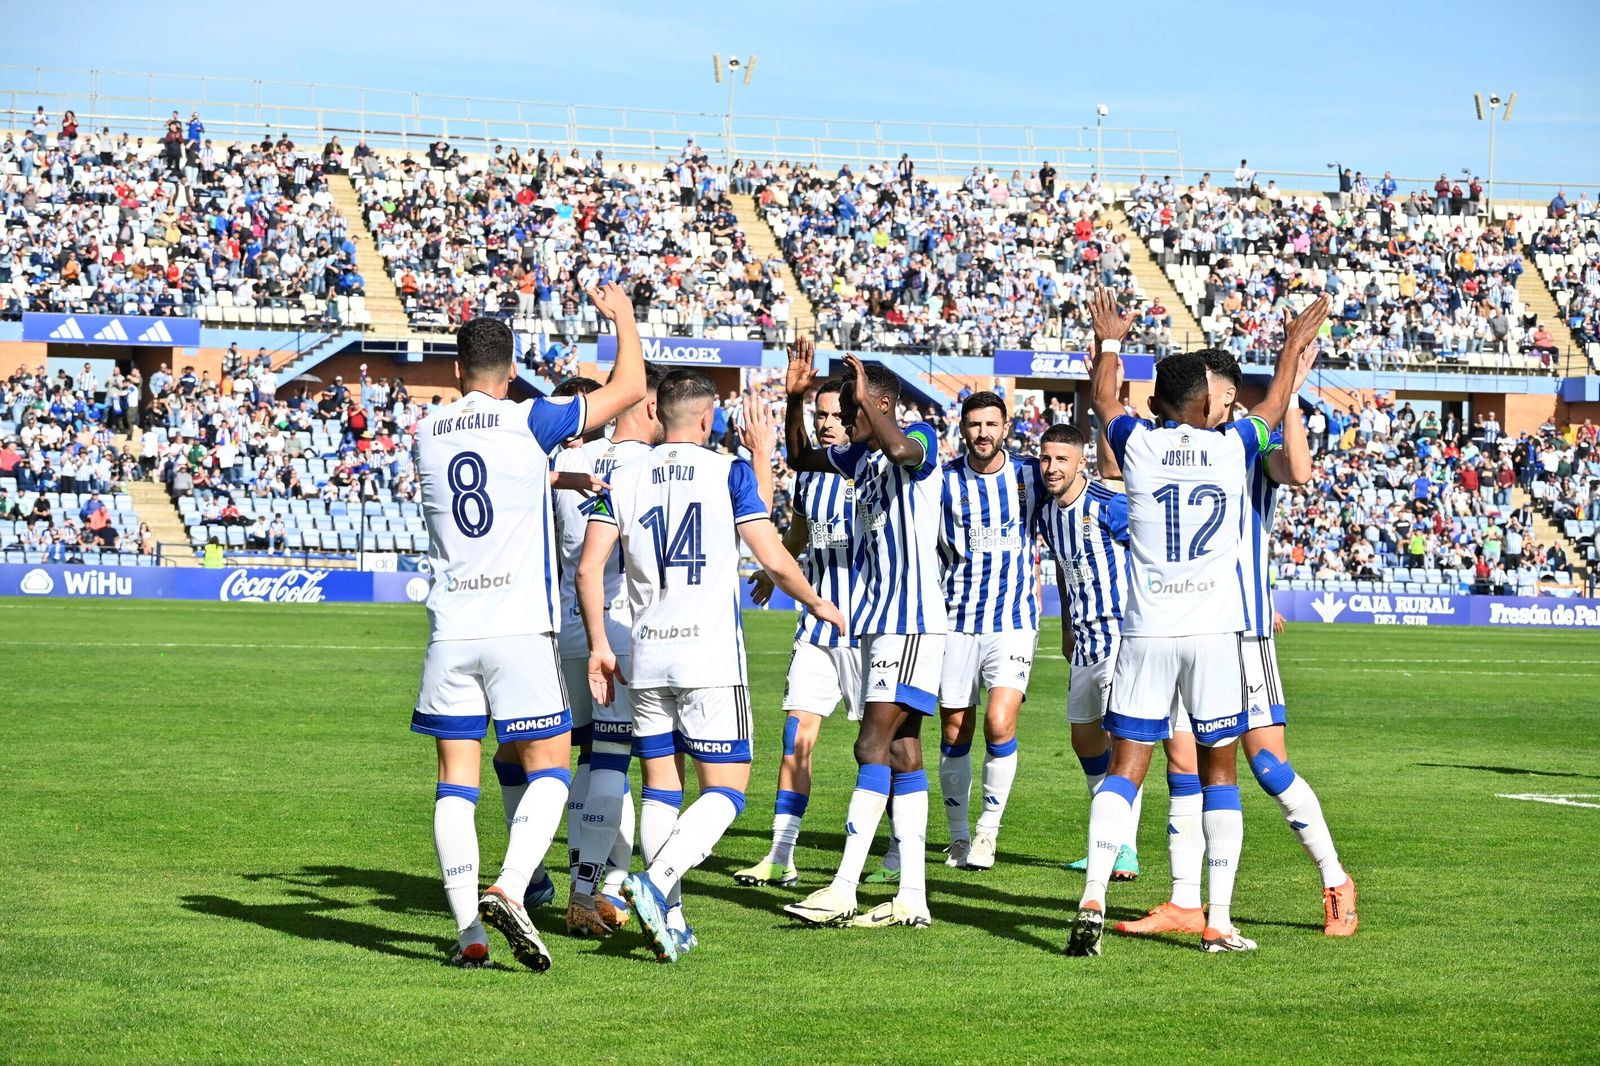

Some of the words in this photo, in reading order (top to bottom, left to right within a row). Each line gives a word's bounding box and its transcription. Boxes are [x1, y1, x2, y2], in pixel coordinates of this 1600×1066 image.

[433, 418, 453, 436] LUIS
[455, 412, 500, 431] ALCALDE
[1161, 450, 1196, 466] JOSIEL
[1200, 450, 1212, 466] N.
[652, 466, 666, 484] DEL
[669, 465, 695, 481] POZO
[447, 451, 494, 538] 8
[1152, 483, 1227, 562] 12
[638, 502, 706, 589] 14
[64, 570, 132, 596] WiHu
[1349, 595, 1392, 613] CAJA
[1395, 596, 1455, 615] RURAL
[1489, 603, 1551, 625] Fresón
[1552, 604, 1574, 625] de
[1374, 614, 1397, 625] DEL
[1403, 615, 1428, 626] SUR
[871, 660, 900, 668] KIA
[506, 714, 562, 733] ROMERO
[1197, 716, 1238, 733] ROMERO
[1096, 840, 1117, 853] 1889
[446, 864, 473, 877] 1889
